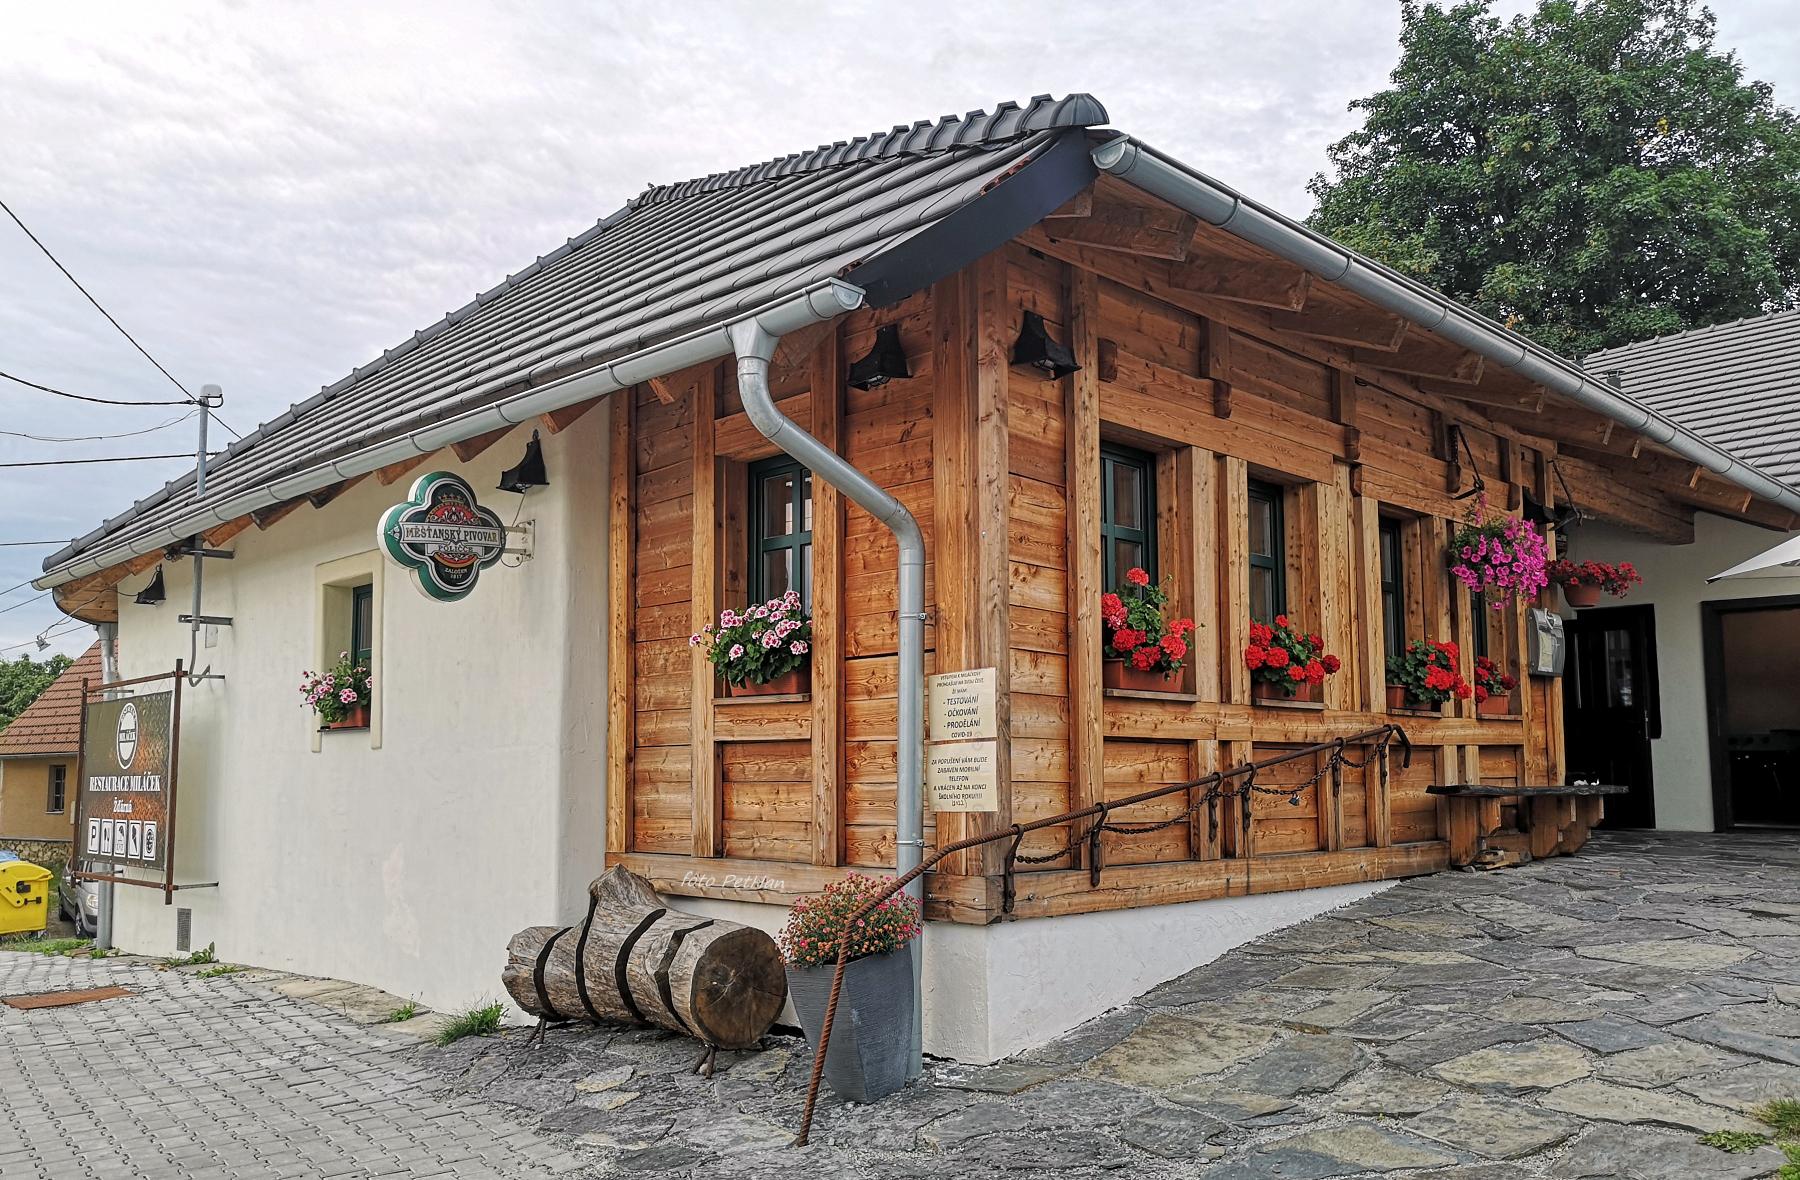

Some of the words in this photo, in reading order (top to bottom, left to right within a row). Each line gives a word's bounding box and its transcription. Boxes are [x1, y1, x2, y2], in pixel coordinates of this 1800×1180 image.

[406, 526, 461, 541] MĚŠŤANSKÝ
[464, 530, 498, 542] PIVOVAR
[947, 694, 979, 705] TESTOVÁNÍ
[948, 706, 978, 717] OČKOVÁNÍ
[947, 718, 980, 728] PRODĚLÁNÍ
[89, 776, 129, 792] RESTAURACE
[130, 772, 160, 792] MILÁČEK
